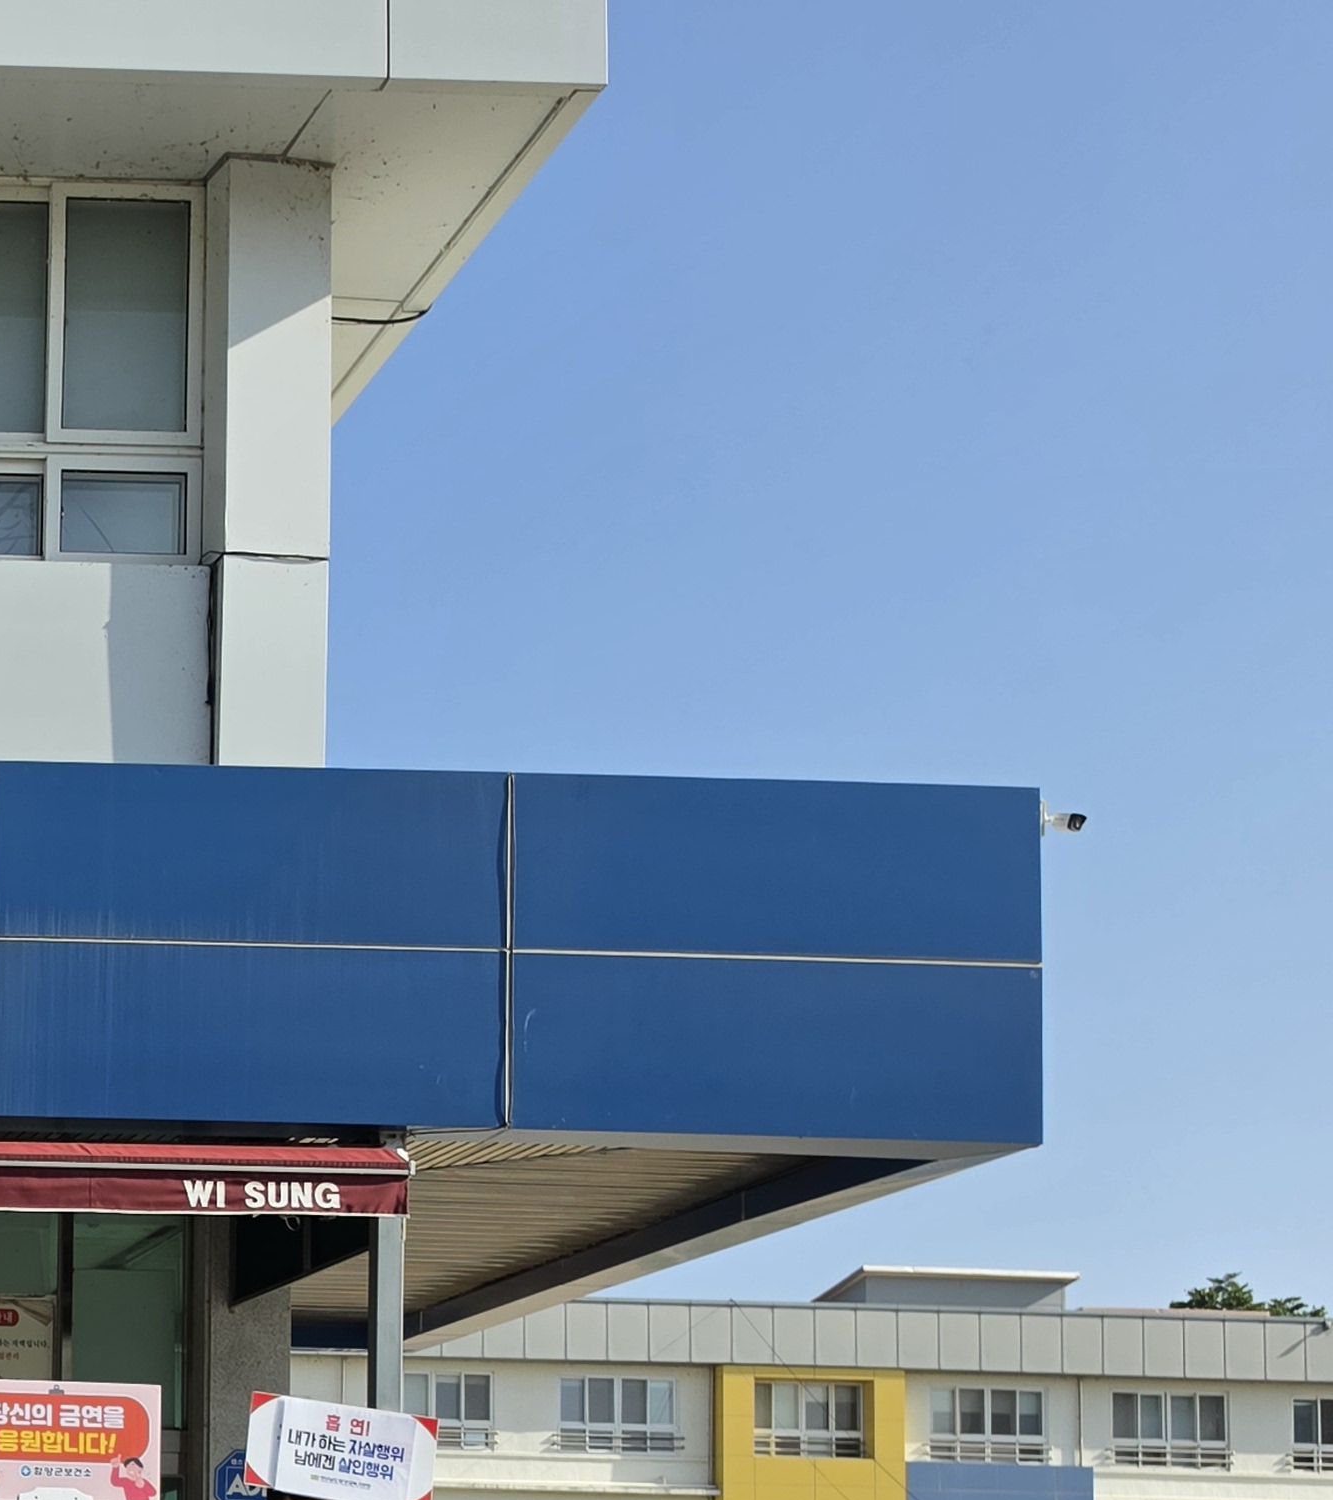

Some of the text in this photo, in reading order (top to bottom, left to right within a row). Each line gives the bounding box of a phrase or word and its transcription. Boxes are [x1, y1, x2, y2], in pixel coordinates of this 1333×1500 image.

[183, 1180, 341, 1210] WI SUNG
[59, 1404, 125, 1429] 금연을
[287, 1429, 405, 1463] 내가 하는 자살행위
[33, 1466, 92, 1478] 함양군보건소
[294, 1450, 395, 1481] 남에겐 살인행위
